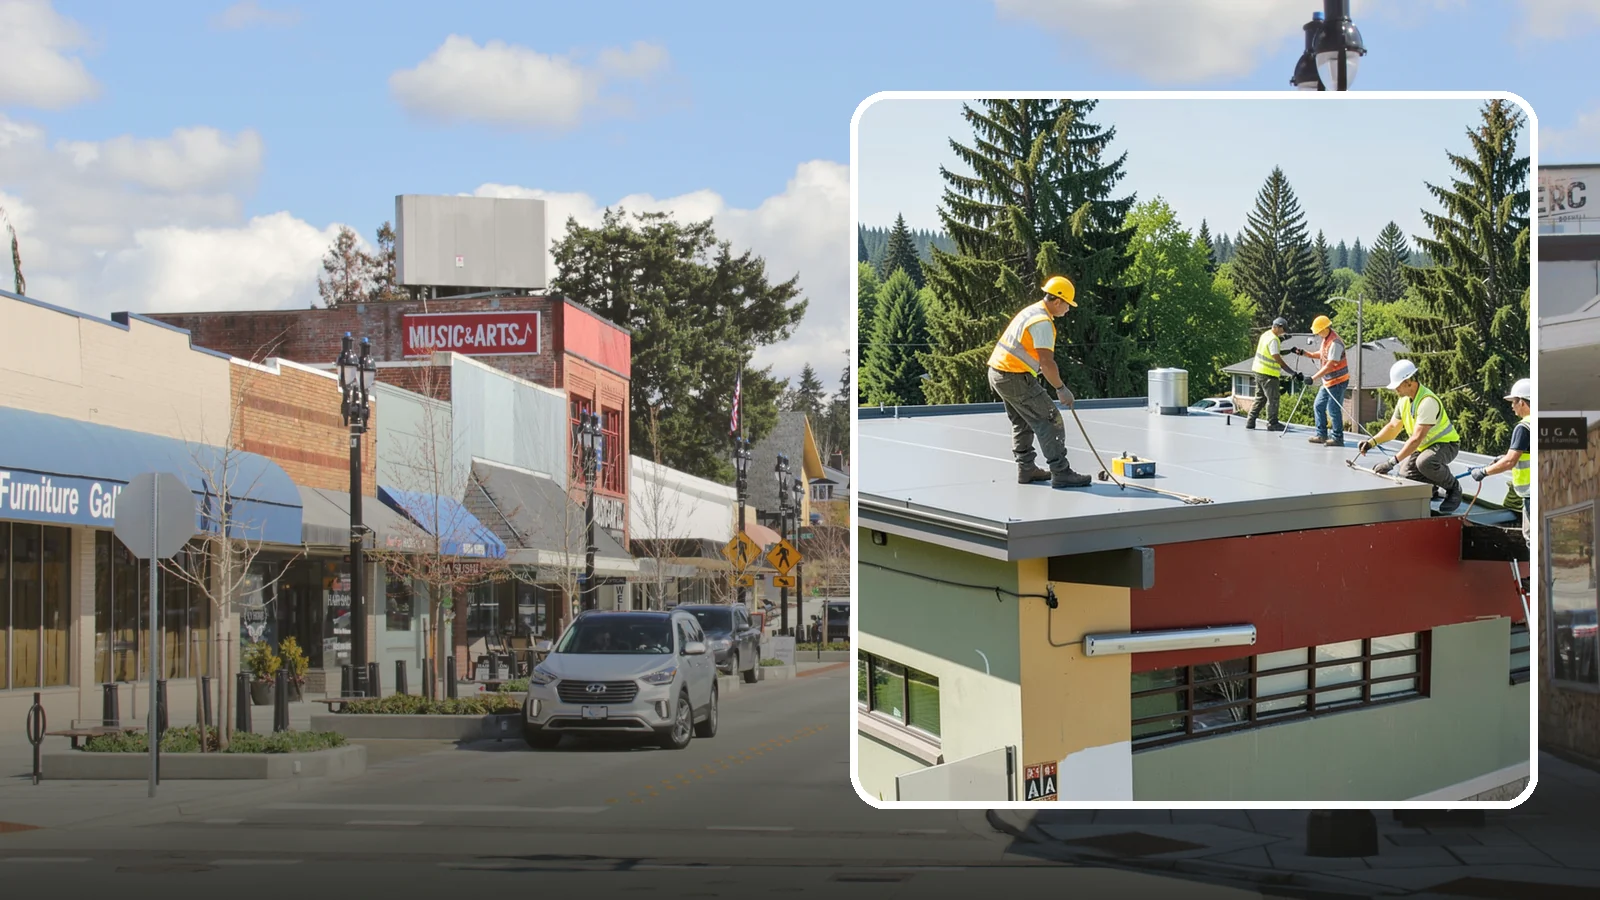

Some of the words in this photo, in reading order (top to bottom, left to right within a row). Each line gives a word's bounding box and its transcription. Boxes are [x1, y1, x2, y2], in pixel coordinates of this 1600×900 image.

[0, 472, 79, 515] Furniture
[89, 482, 122, 519] Gal
[453, 563, 479, 574] SUSHI
